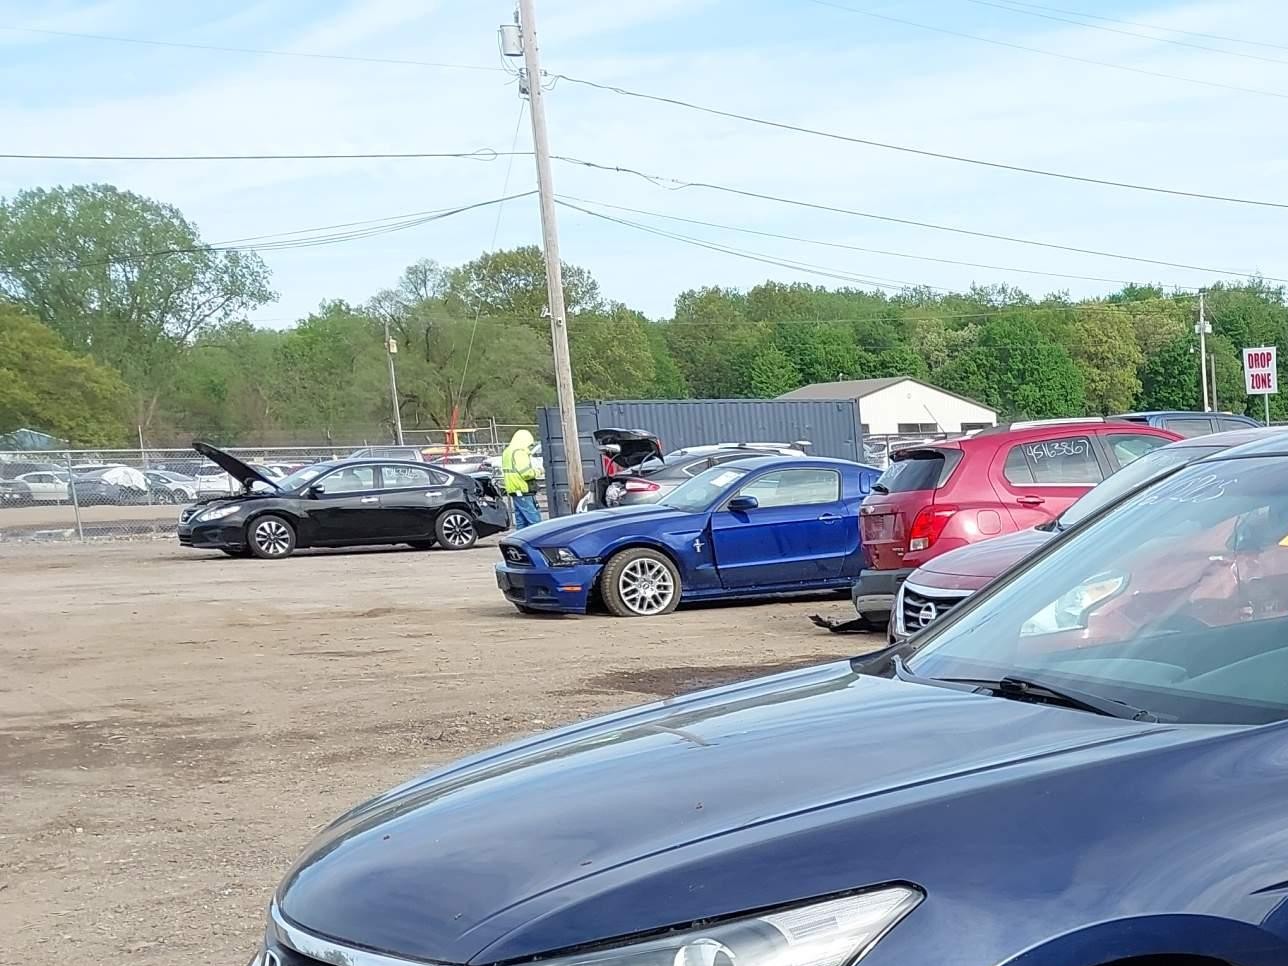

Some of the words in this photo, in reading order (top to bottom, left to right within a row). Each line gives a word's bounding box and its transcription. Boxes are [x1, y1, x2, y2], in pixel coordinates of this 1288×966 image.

[1247, 352, 1272, 369] DROP
[1250, 372, 1272, 390] ZONE
[1026, 439, 1090, 464] 45163867
